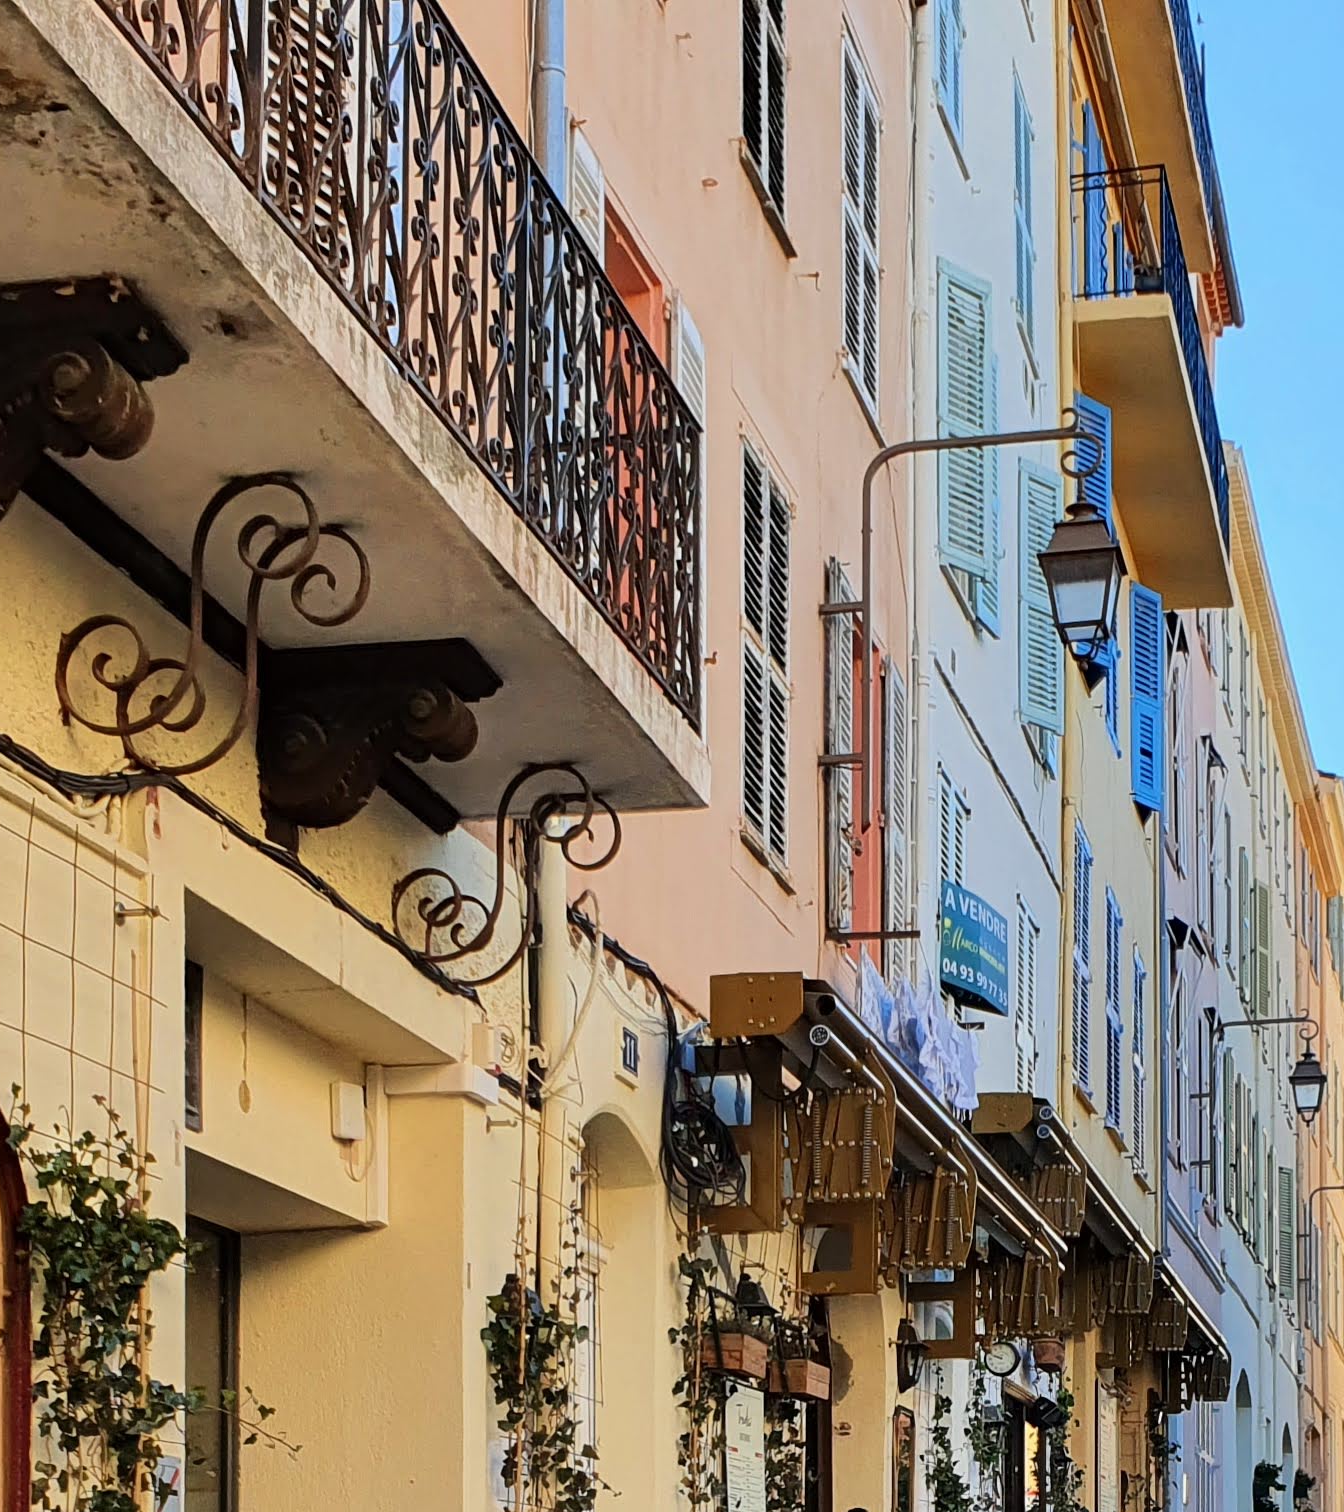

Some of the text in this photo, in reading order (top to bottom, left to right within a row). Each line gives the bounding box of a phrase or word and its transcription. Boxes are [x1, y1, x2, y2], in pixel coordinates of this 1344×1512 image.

[945, 887, 1007, 944] A VENDRE
[942, 957, 958, 977] 04
[959, 965, 974, 983] 93
[976, 971, 988, 989] 99
[988, 978, 997, 998] 77
[998, 987, 1007, 1007] 35
[626, 1036, 635, 1069] 11
